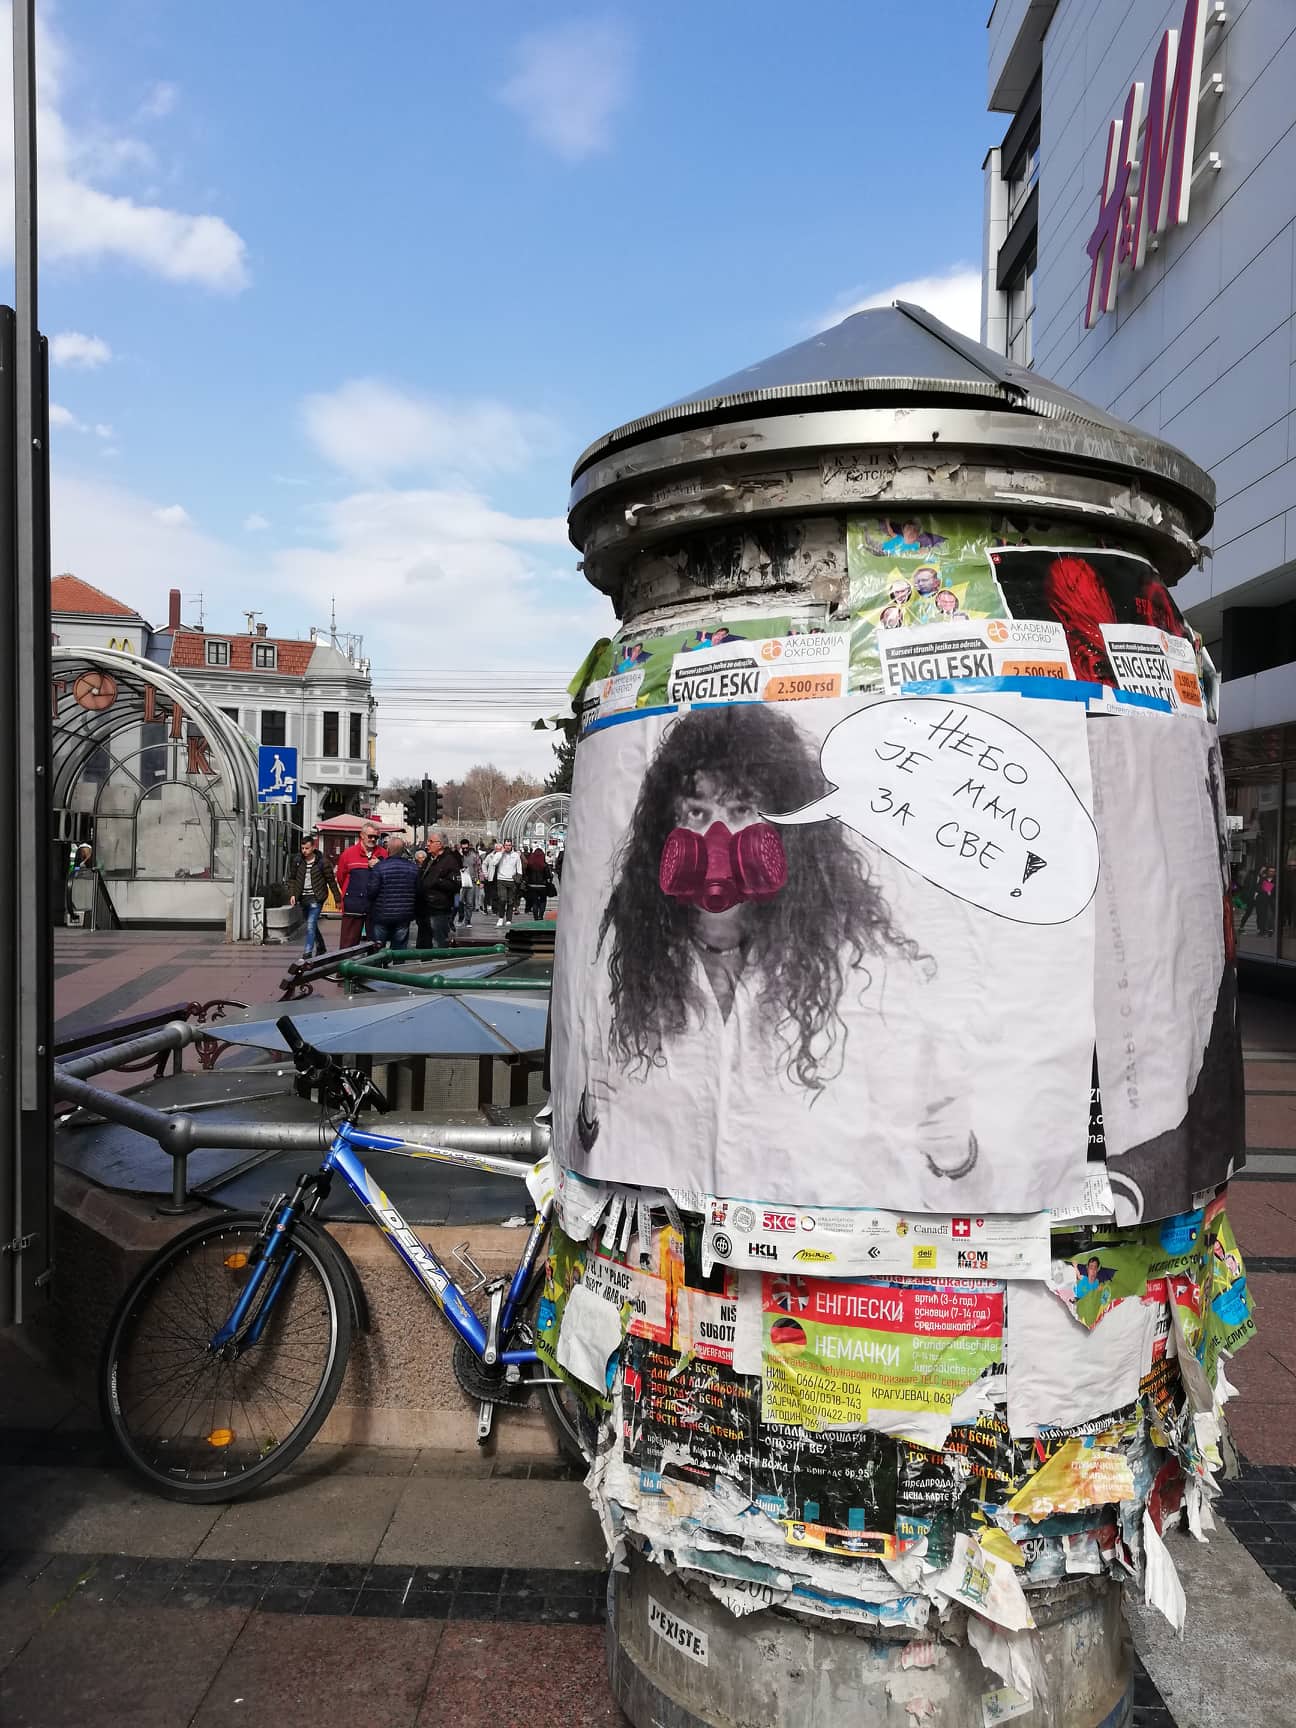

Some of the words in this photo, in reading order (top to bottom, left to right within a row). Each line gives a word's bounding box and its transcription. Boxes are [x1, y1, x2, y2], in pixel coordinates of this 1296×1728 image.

[786, 635, 844, 648] AKADEMIJA
[1012, 633, 1052, 644] OXFORD
[784, 646, 831, 658] OXFORD
[888, 653, 994, 687] ENGLESKI
[1113, 655, 1172, 681] ENGLESKI
[672, 670, 761, 703] ENGLESKI
[777, 679, 812, 695] 2.500
[814, 679, 834, 692] rsd
[914, 1224, 949, 1236] Canada
[380, 1208, 450, 1296] DEMA
[816, 1292, 904, 1323] ЕНГЛЕСКИ
[815, 1335, 900, 1367] НЕМАЧКИ
[796, 1373, 861, 1395] 066/422-004
[799, 1389, 862, 1410] 060/0518-143
[803, 1405, 862, 1423] 060/0422-019
[650, 1604, 705, 1656] J'EXISTE.
